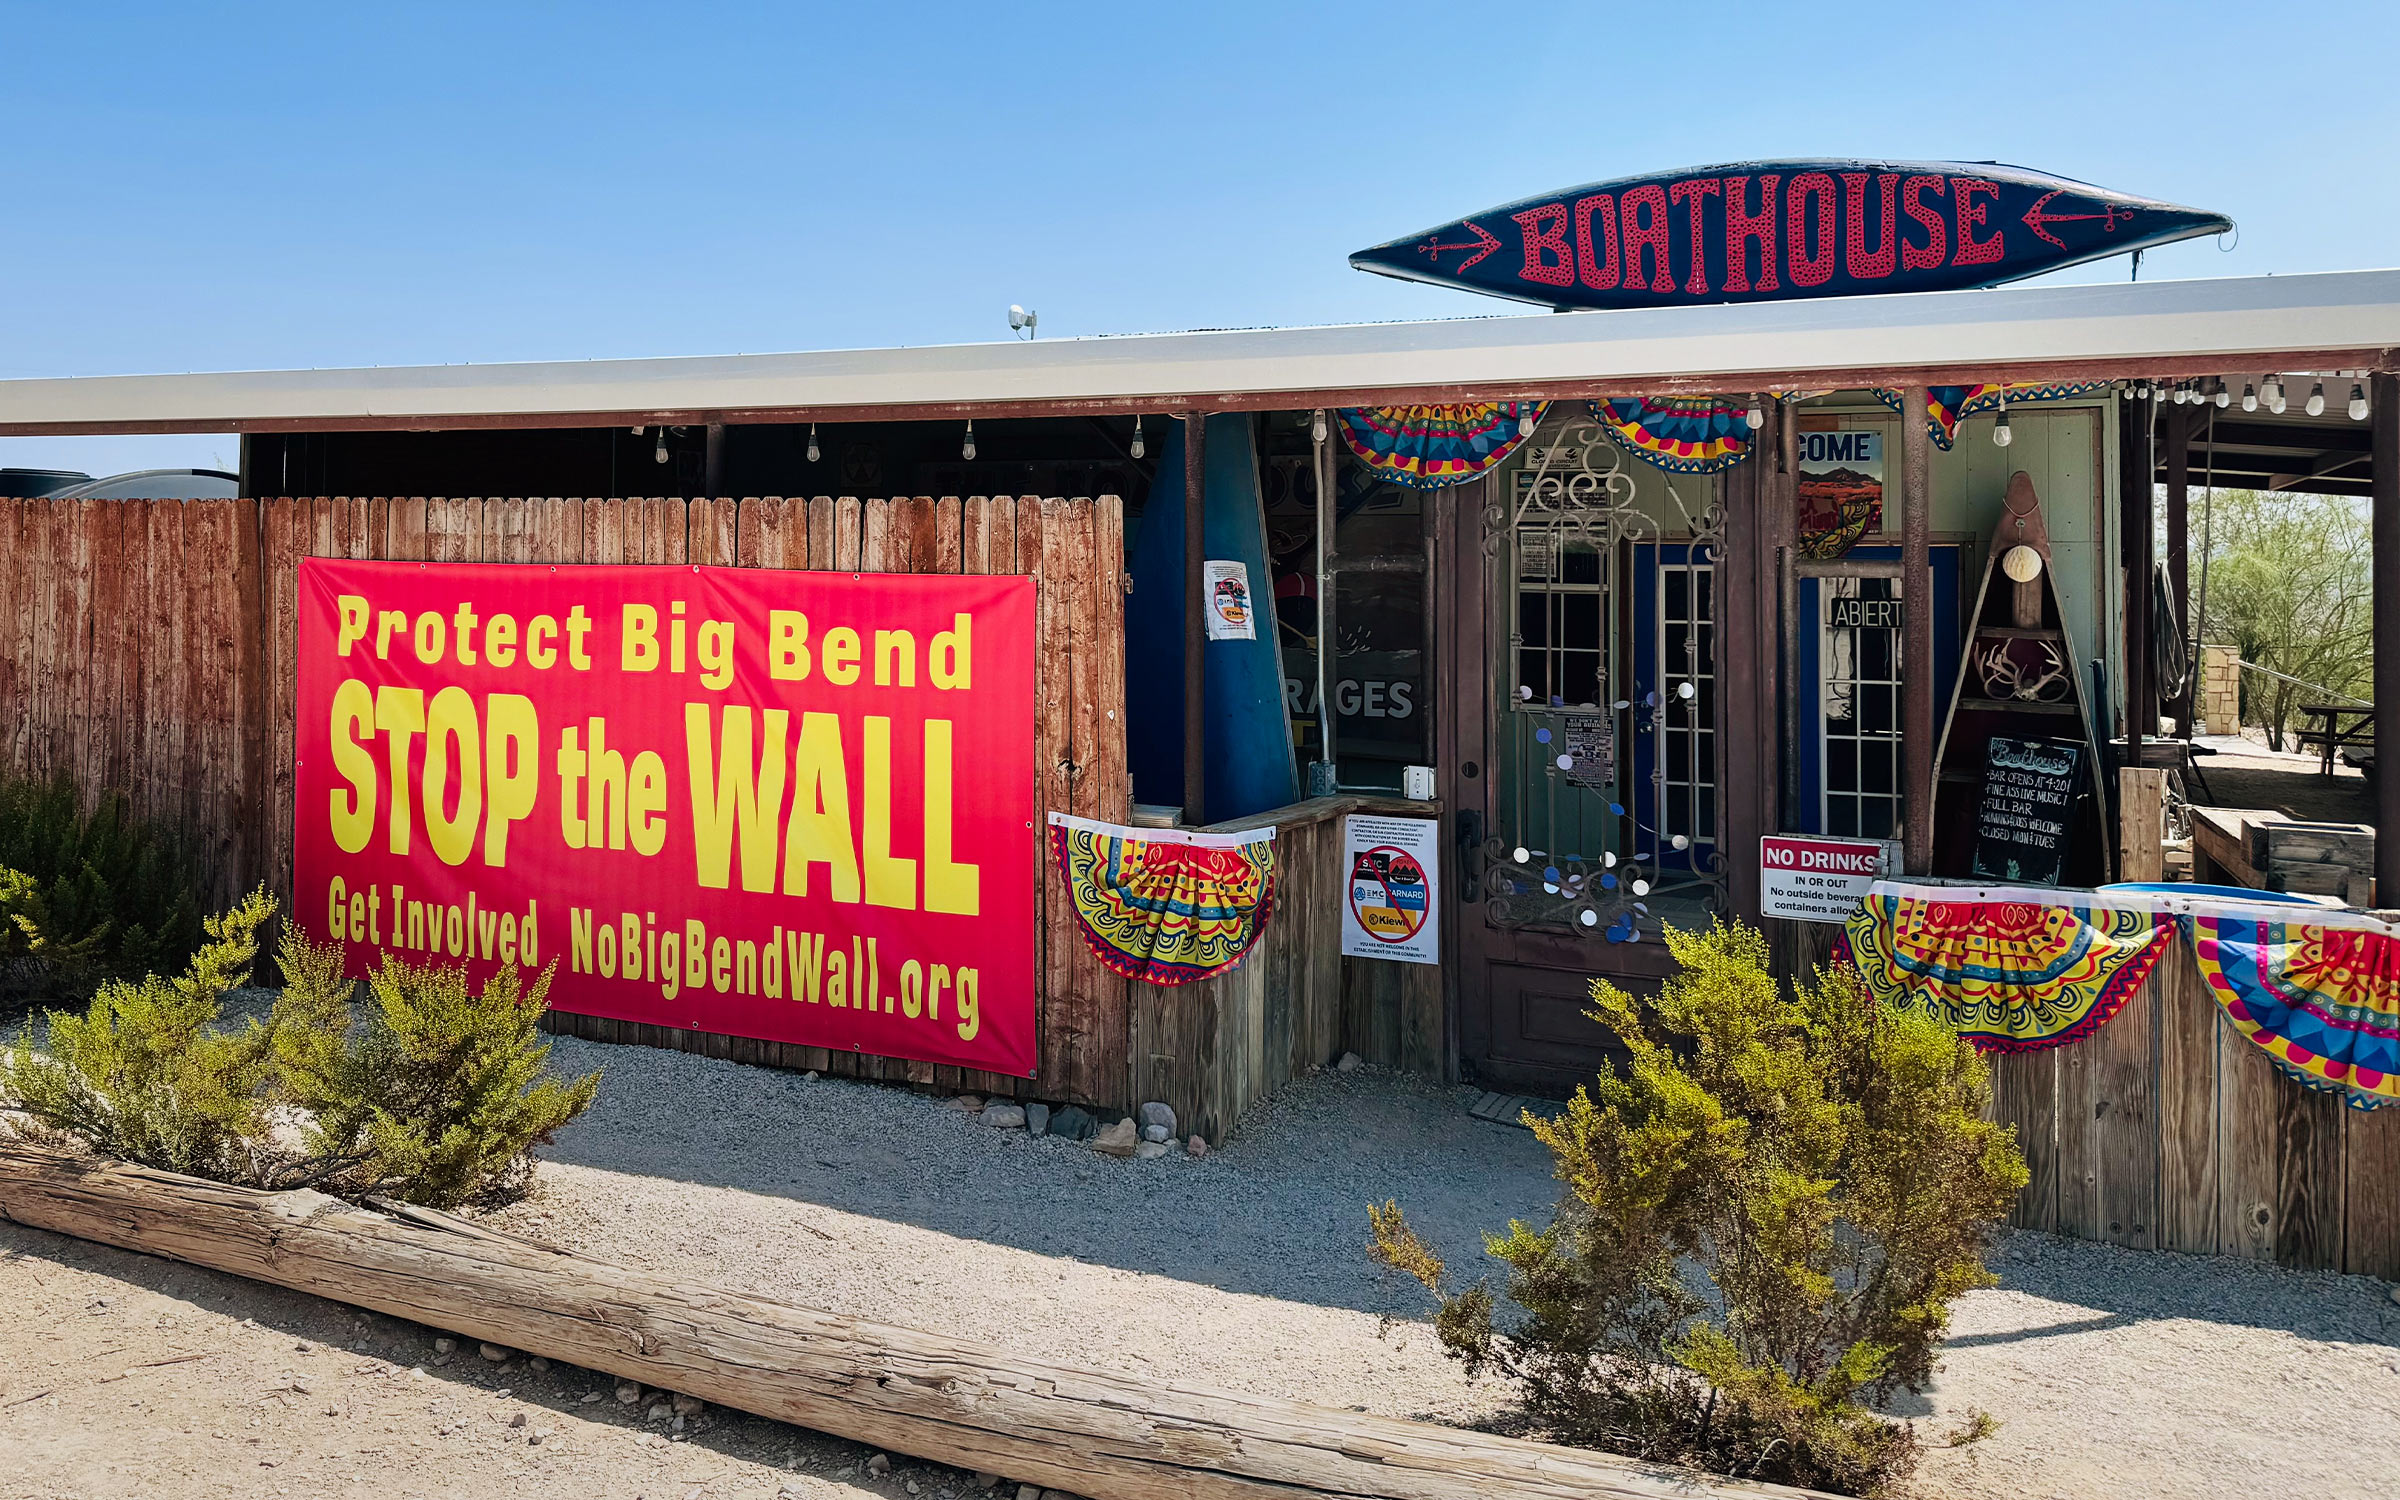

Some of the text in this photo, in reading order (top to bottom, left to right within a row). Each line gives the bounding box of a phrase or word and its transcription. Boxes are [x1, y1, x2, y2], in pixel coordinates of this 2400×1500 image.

[1511, 173, 2005, 294] BOATHOUSE
[1835, 600, 1902, 627] ABIERT
[339, 597, 971, 690] Protect Big Bend
[1989, 769, 2006, 781] BAR
[2008, 772, 2033, 786] OPENS
[2035, 776, 2046, 788] AT
[330, 680, 979, 915] STOP the WALL
[1986, 783, 2006, 796] FINE
[2020, 788, 2036, 801] LIVE
[1986, 797, 2033, 816] FULL BAR
[1981, 825, 2010, 841] CLOSED
[1766, 847, 1876, 872] NO DRINKS
[1795, 876, 1848, 888] IN OR OUT
[1387, 889, 1424, 899] ARNARD
[1770, 887, 1864, 904] No outside bevera
[1774, 901, 1853, 915] containers allo
[1379, 915, 1407, 926] Kiew
[329, 877, 979, 1040] Get Involved NoBigBendWall.org
